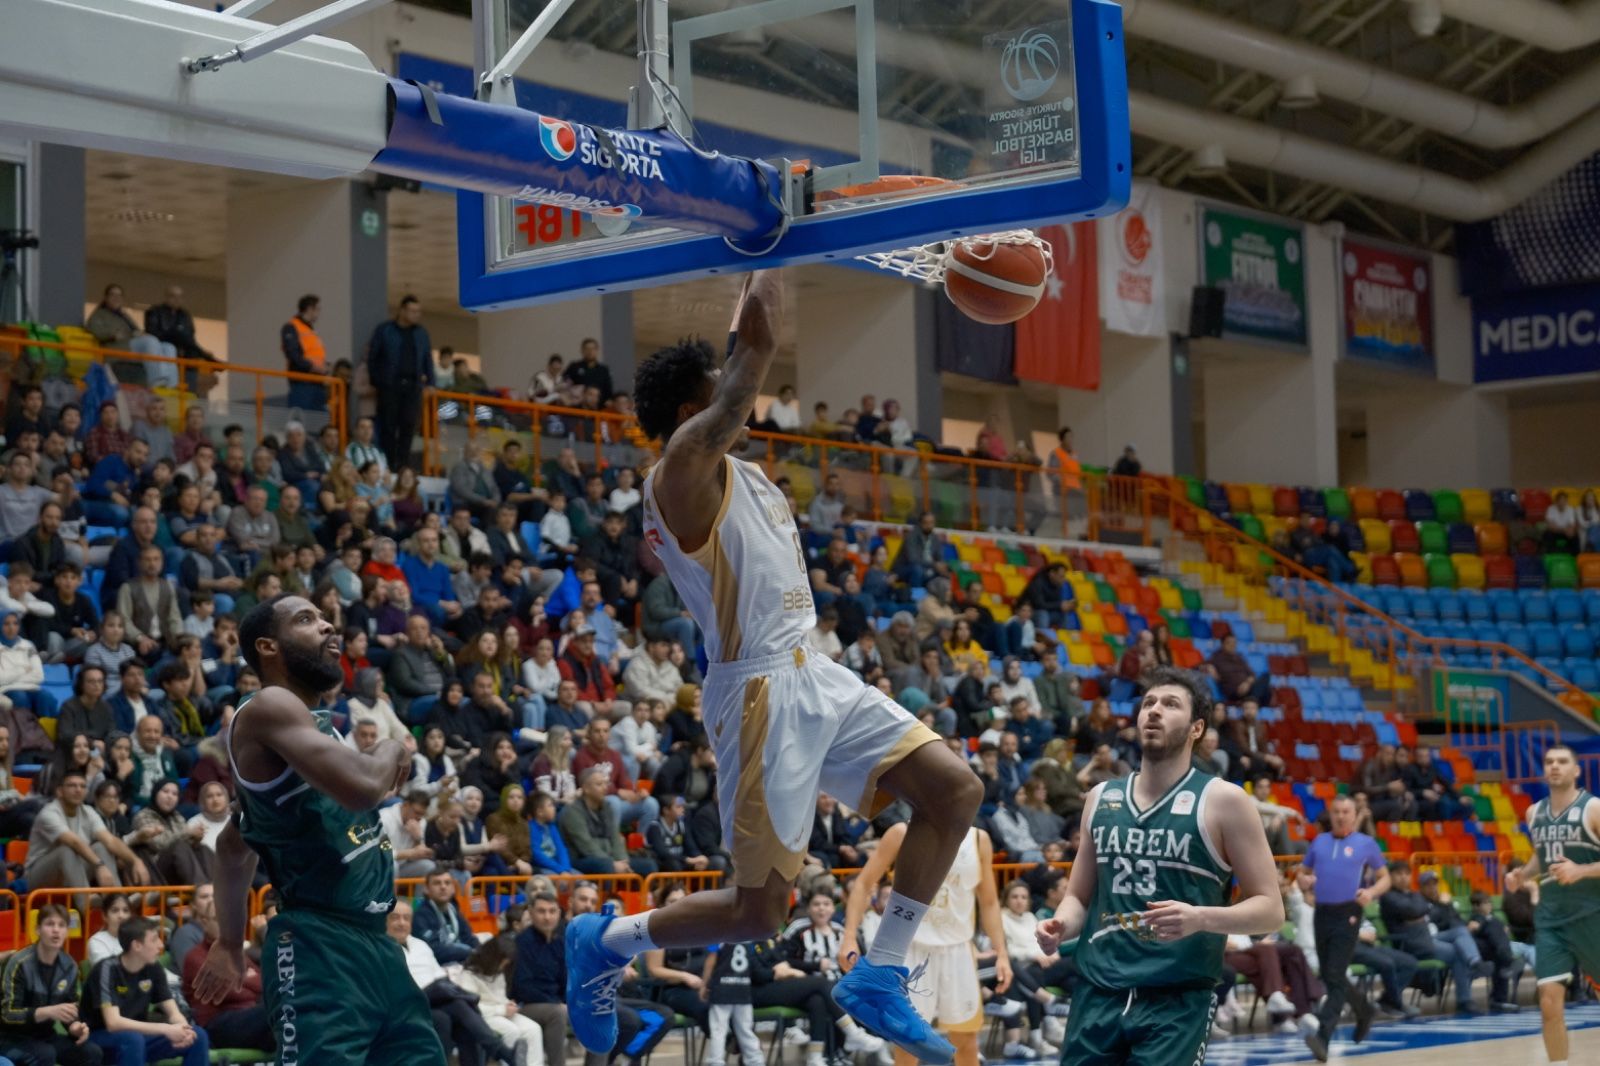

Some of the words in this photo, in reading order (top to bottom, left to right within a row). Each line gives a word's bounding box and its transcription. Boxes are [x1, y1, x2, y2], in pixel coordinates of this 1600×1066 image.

[1480, 309, 1600, 356] MEDIC
[1092, 825, 1193, 863] HAREM
[1544, 841, 1564, 863] 10
[1112, 857, 1157, 896] 23
[892, 905, 915, 921] 23
[730, 943, 749, 973] 8
